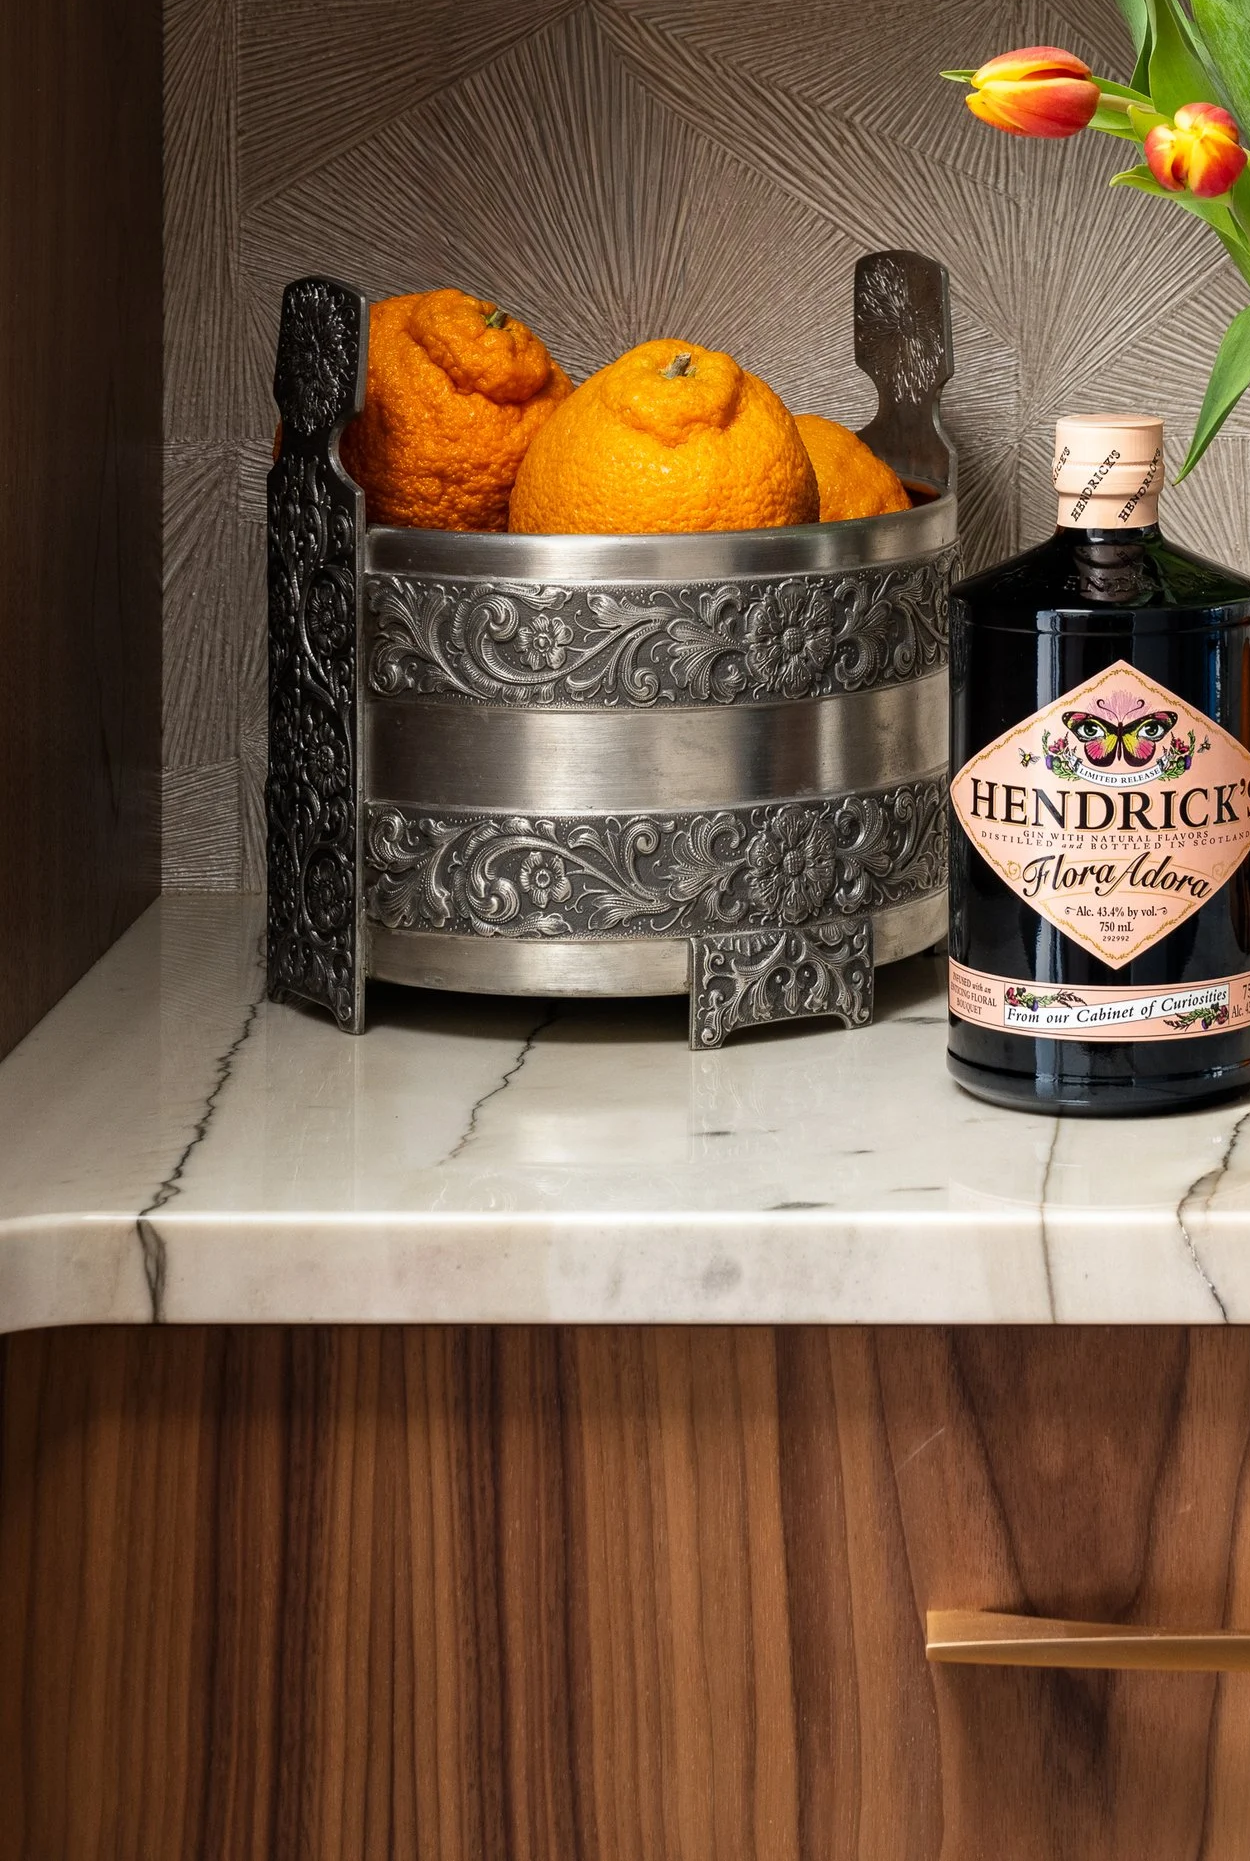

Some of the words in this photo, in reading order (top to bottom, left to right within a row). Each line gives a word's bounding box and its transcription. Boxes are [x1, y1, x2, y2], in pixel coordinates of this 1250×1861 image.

[1070, 449, 1121, 522] HENDRICK'S
[1118, 447, 1161, 522] HENDRICK'S
[1079, 767, 1118, 784] LIMITED
[1120, 767, 1161, 784] RELEASE
[981, 830, 1053, 847] DISTILLED
[1061, 842, 1083, 850] and
[1090, 842, 1162, 851] BOTTLED
[1170, 841, 1186, 849] IN
[1193, 830, 1250, 847] SCOTLAND
[1023, 830, 1044, 839] GIN
[1050, 832, 1084, 842] WITH
[1091, 834, 1151, 843] NATURAL
[1157, 830, 1209, 842] FLAVORS
[1076, 906, 1095, 917] Alc.
[1097, 906, 1125, 917] 43.4%
[1127, 906, 1138, 920] by
[1141, 906, 1158, 917] vol.
[1099, 921, 1115, 932] 750
[1117, 921, 1134, 932] mL
[972, 982, 984, 992] with
[956, 997, 982, 1015] BOUQUET
[971, 992, 997, 1007] FLORAL
[1007, 1007, 1040, 1023] From
[1046, 1013, 1070, 1024] our
[1076, 1009, 1134, 1023] Cabinet
[1140, 1000, 1157, 1019] of
[1161, 989, 1228, 1012] Curiosities
[1231, 1004, 1244, 1018] Alc.
